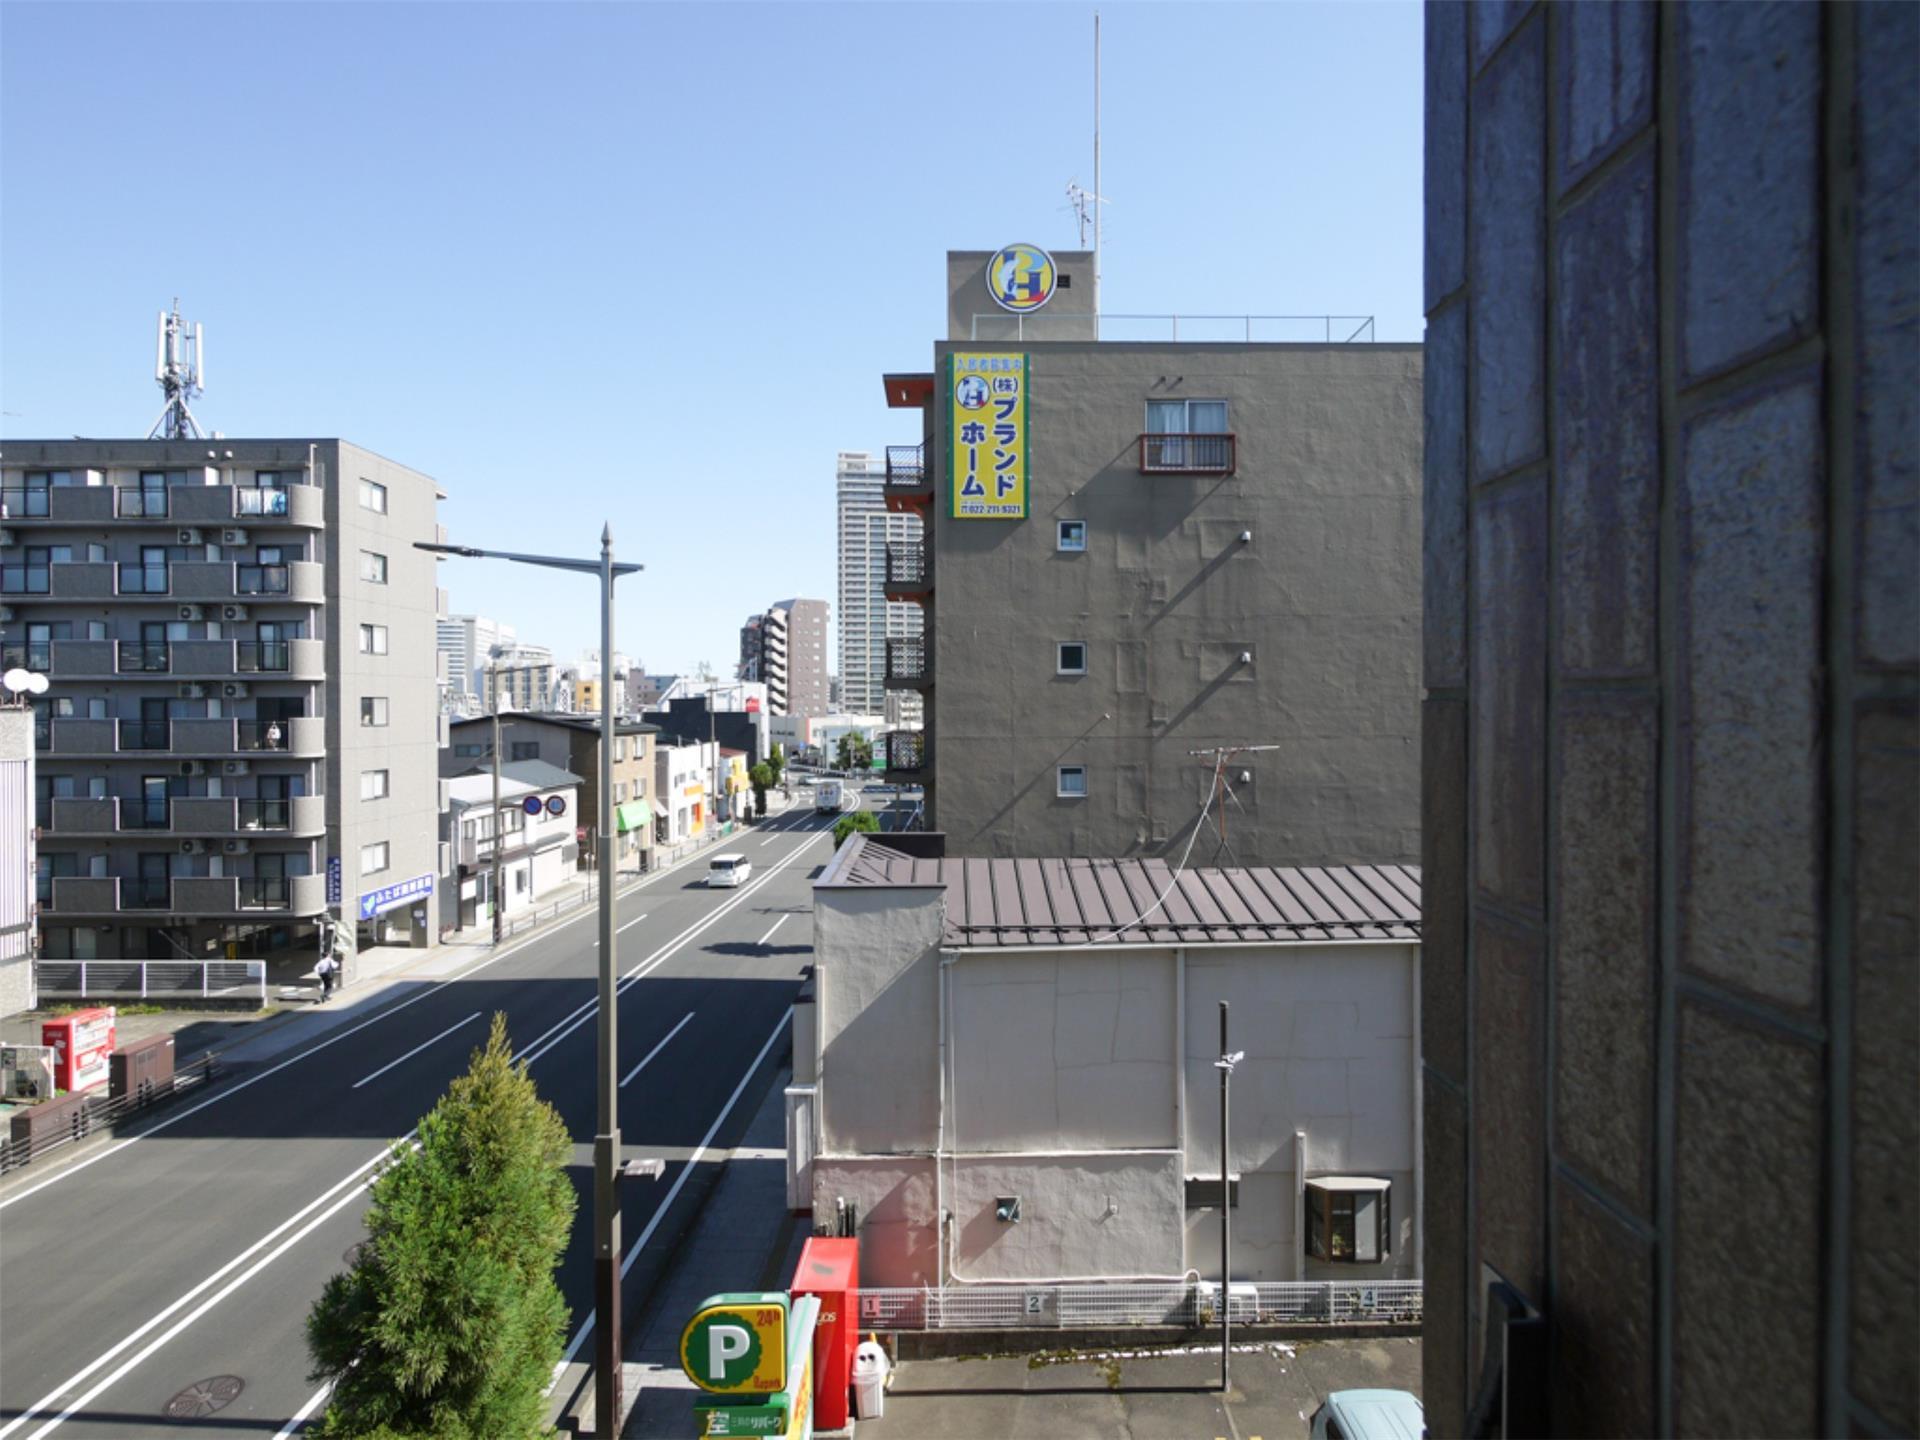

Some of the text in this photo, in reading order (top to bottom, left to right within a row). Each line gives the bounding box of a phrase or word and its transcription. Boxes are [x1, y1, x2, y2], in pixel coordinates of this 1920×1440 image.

[961, 422, 985, 496] ホーム
[1029, 1296, 1040, 1309] 2
[1363, 1290, 1373, 1302] 4
[708, 1325, 750, 1379] P
